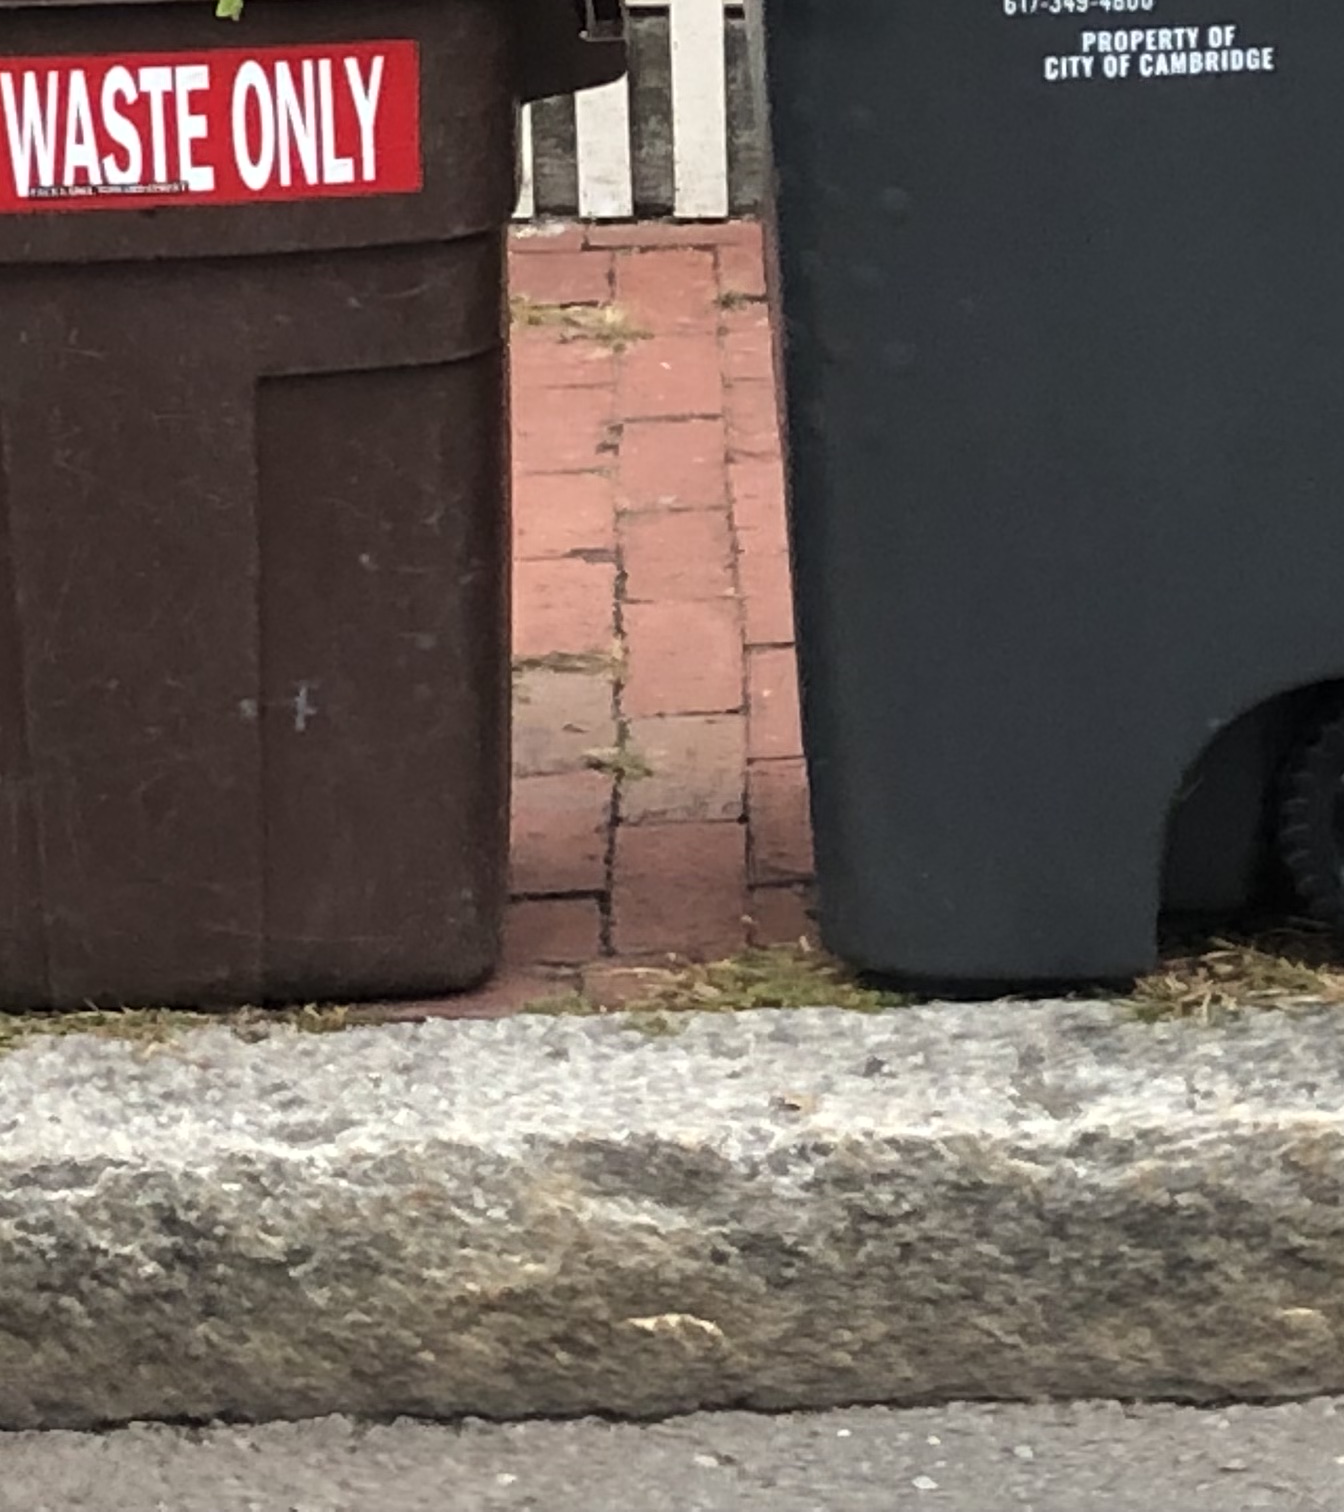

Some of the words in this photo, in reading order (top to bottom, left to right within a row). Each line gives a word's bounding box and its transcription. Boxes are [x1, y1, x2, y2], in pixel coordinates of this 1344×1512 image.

[1082, 27, 1199, 52] PROPERTY
[1208, 25, 1236, 48] OF
[1044, 55, 1094, 80] CITY
[1103, 54, 1131, 78] OF
[1139, 48, 1274, 77] CAMBRIDGE
[0, 64, 214, 197] WASTE
[231, 55, 384, 190] ONLY
